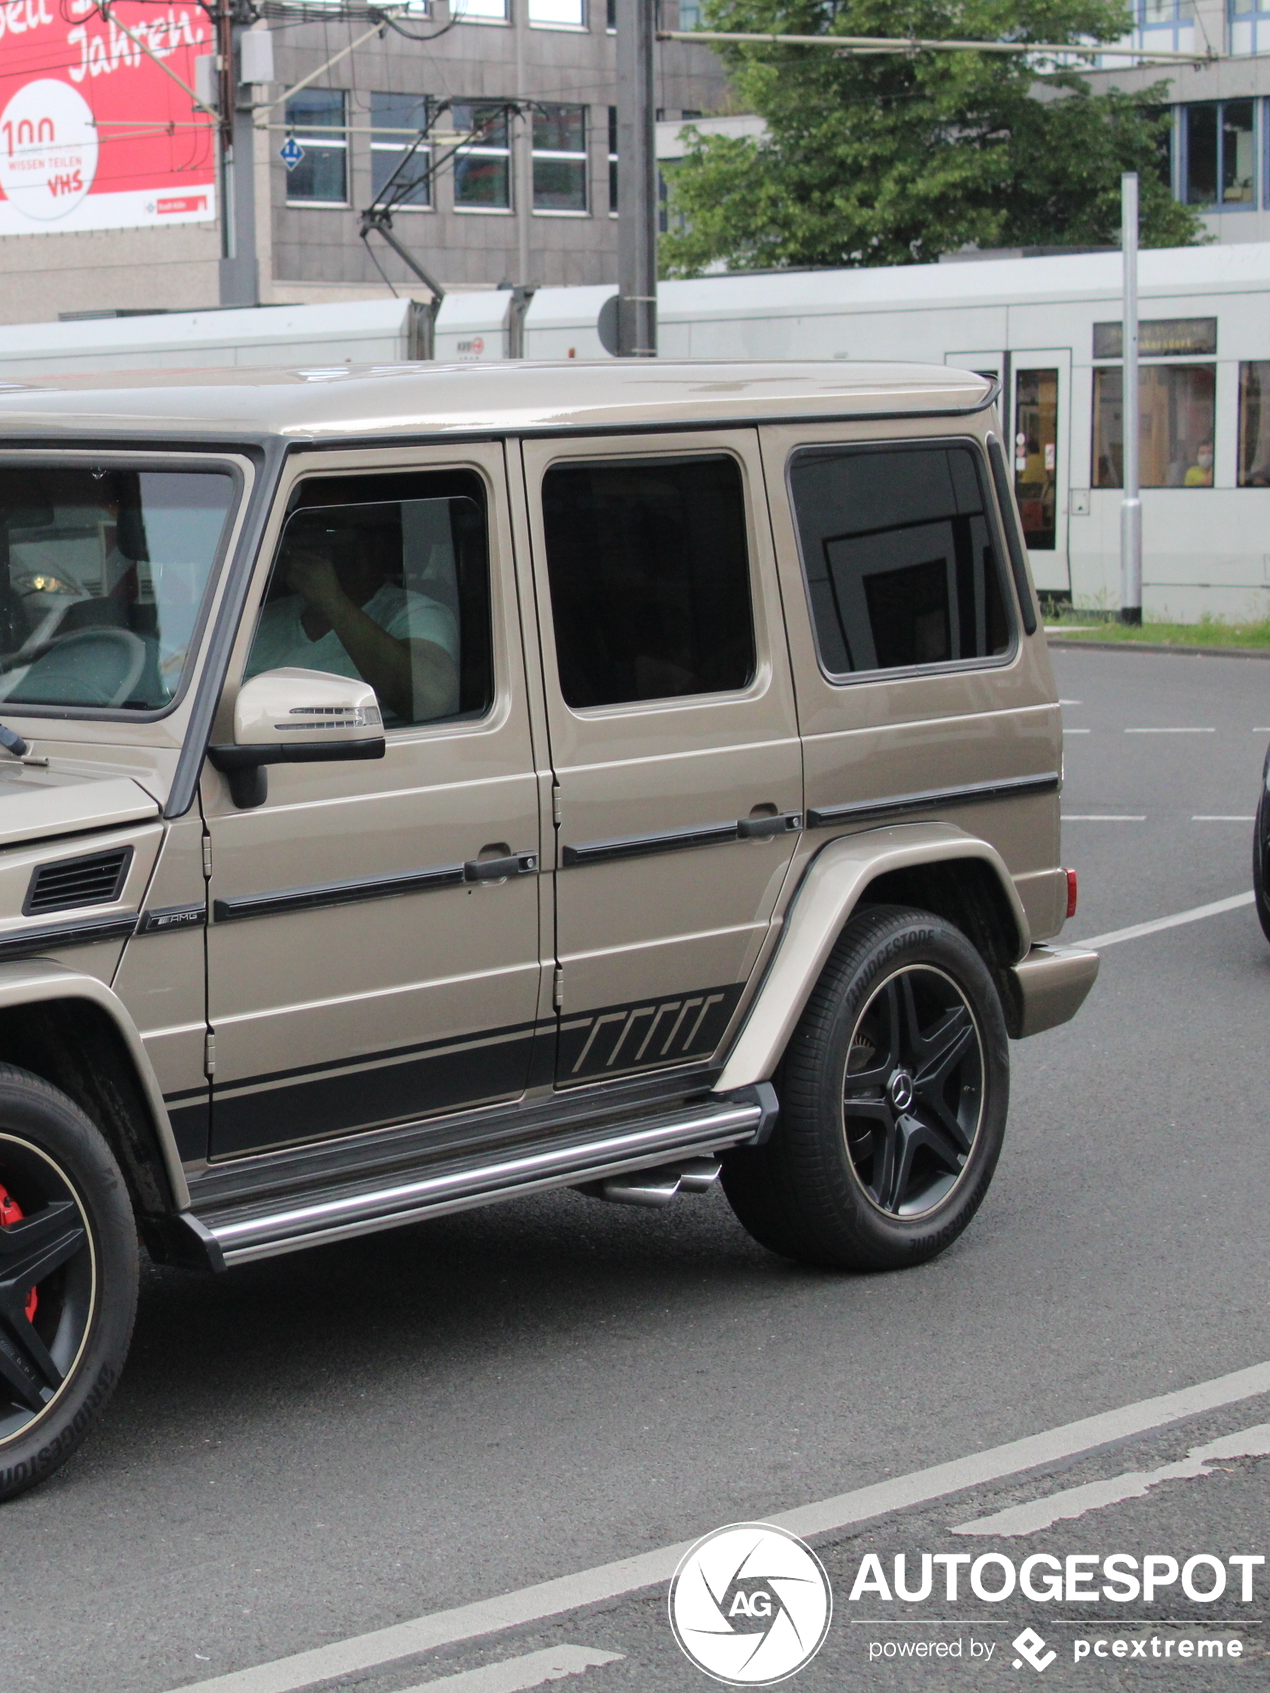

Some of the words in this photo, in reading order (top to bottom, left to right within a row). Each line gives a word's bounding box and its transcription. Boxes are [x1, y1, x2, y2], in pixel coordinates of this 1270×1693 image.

[9, 160, 45, 171] WISSEN
[48, 156, 82, 168] TEILEN
[47, 169, 84, 198] VHS
[170, 913, 198, 923] AMG
[846, 929, 935, 1017] BRIDGESTONE
